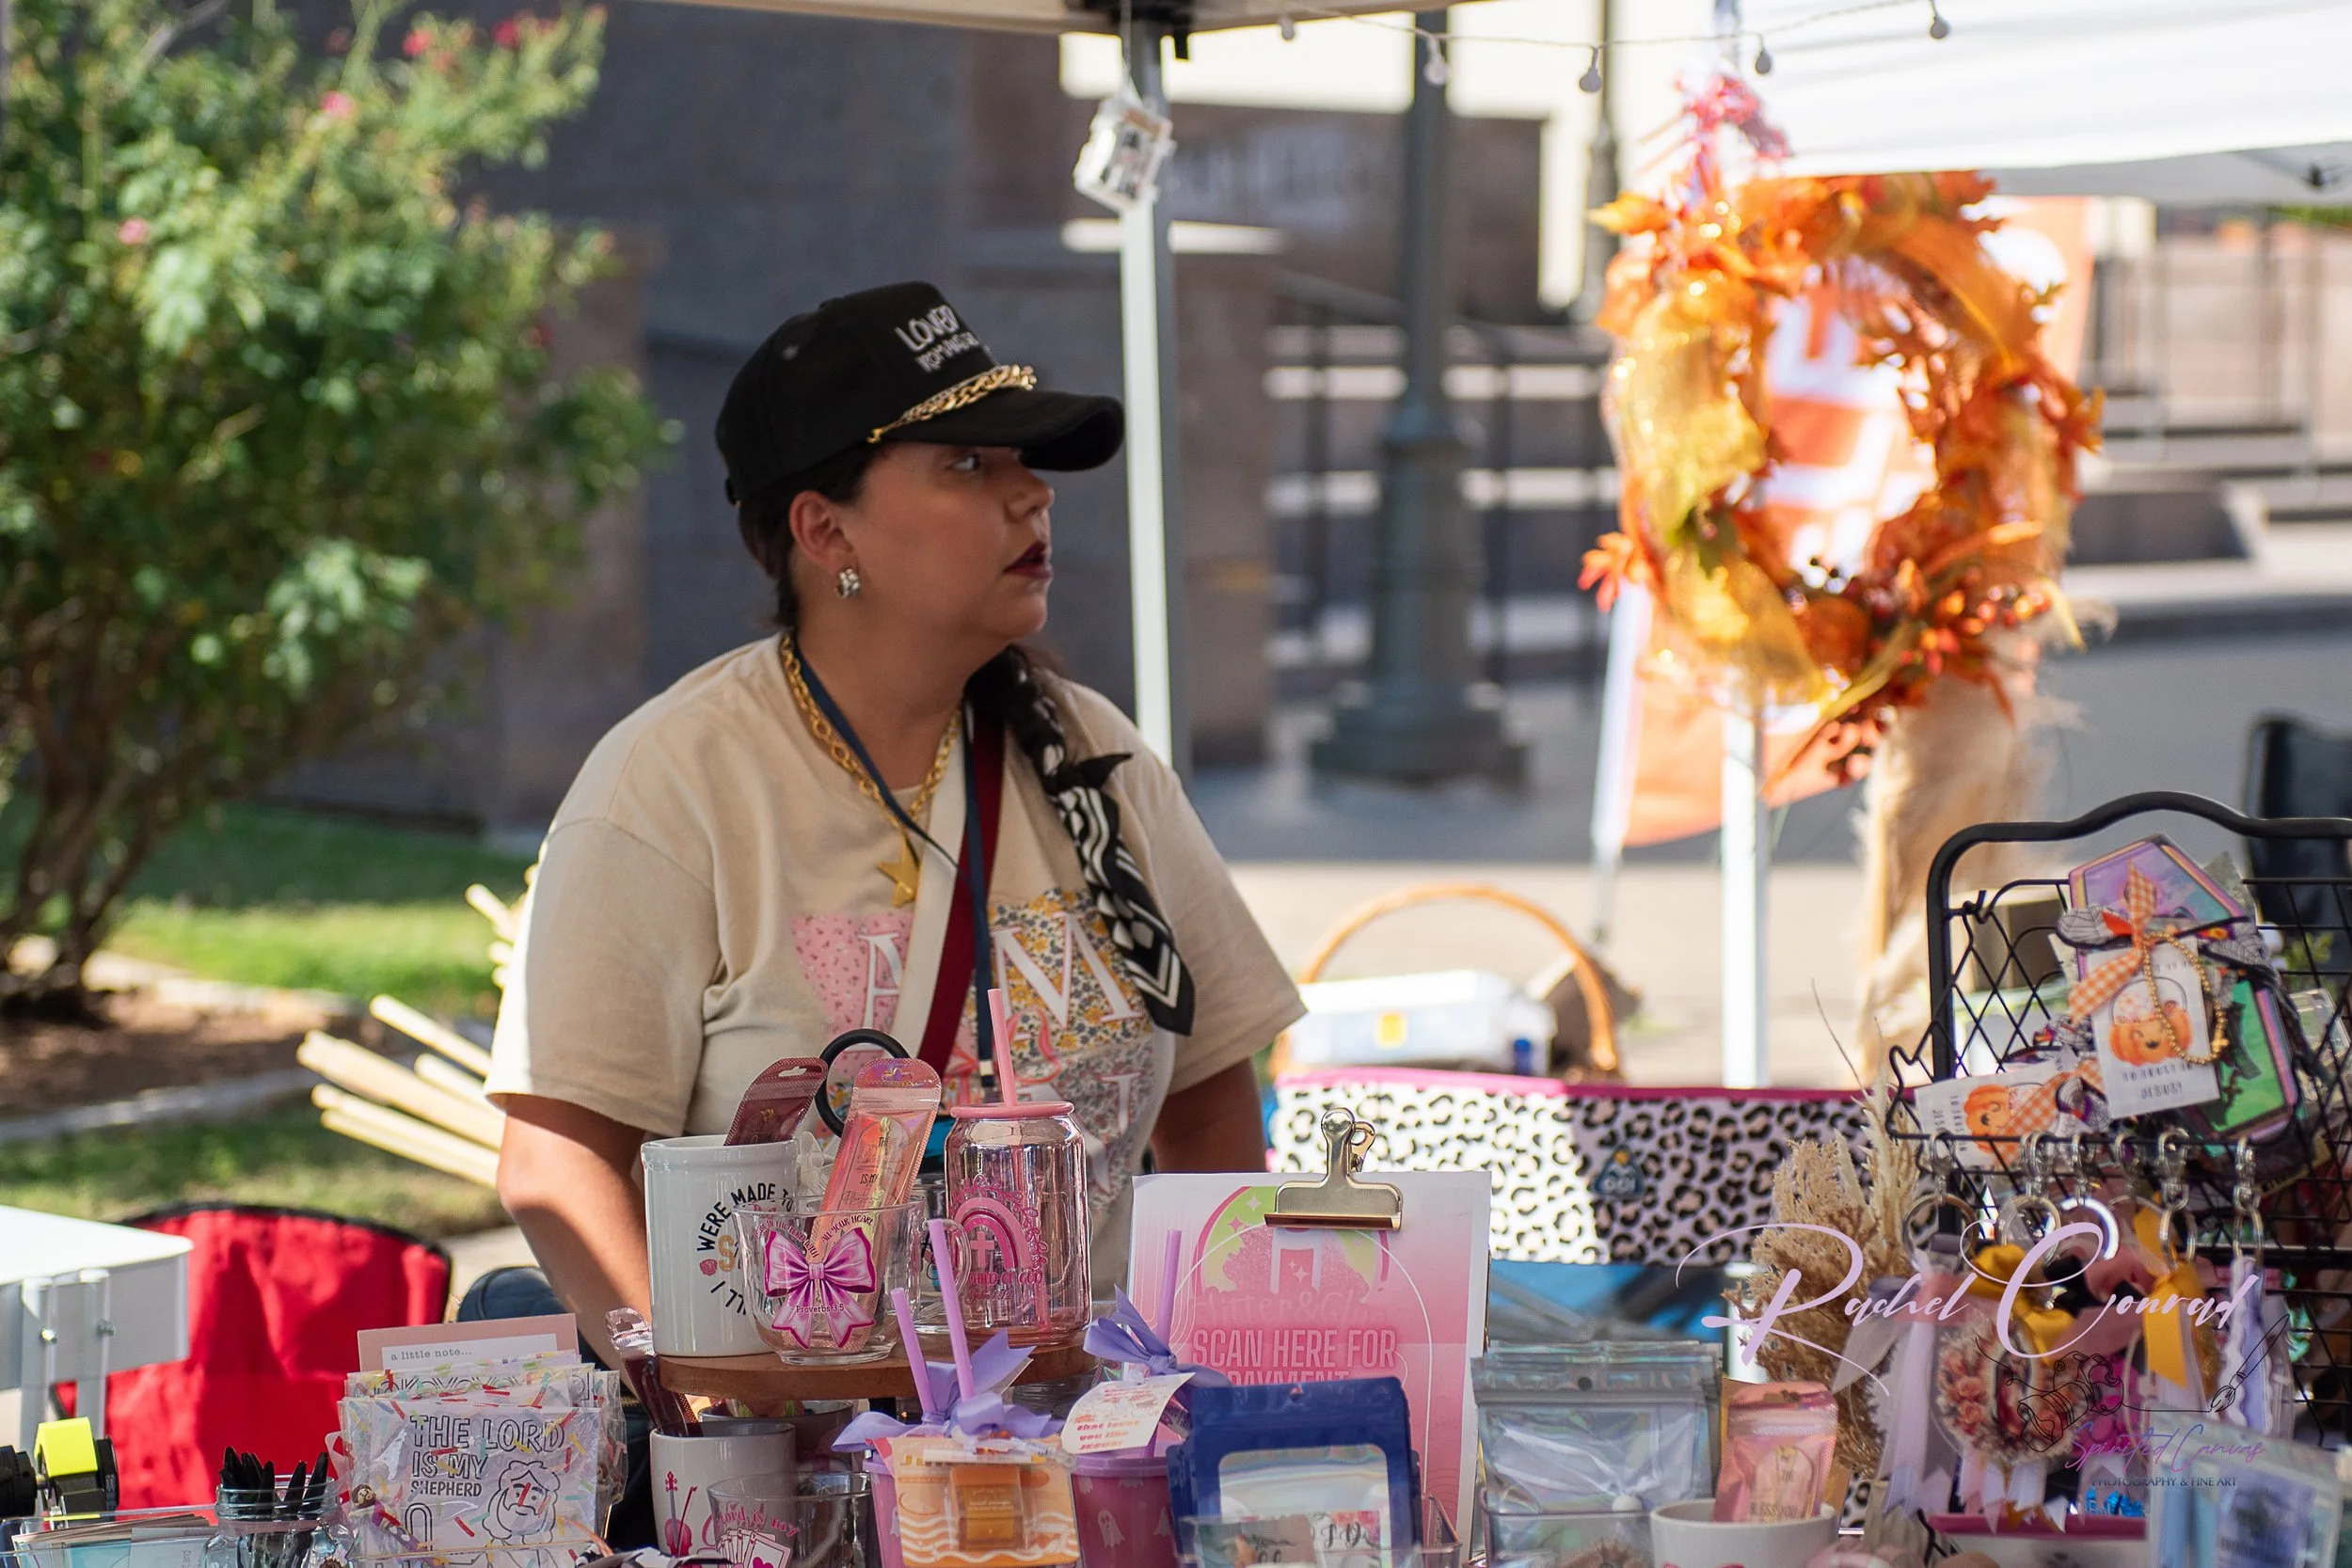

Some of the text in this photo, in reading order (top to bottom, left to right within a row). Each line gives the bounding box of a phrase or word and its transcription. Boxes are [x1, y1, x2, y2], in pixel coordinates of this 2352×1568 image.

[697, 1201, 732, 1251] WERE
[730, 1182, 776, 1206] MADE
[796, 1304, 830, 1313] Proverbs
[390, 1353, 398, 1361] a
[402, 1348, 430, 1360] little
[1192, 1328, 1398, 1369] SCAN HERE FOR
[410, 1414, 565, 1453] THE LORD
[411, 1450, 489, 1481] IS MY
[410, 1480, 483, 1497] SHEPHERD
